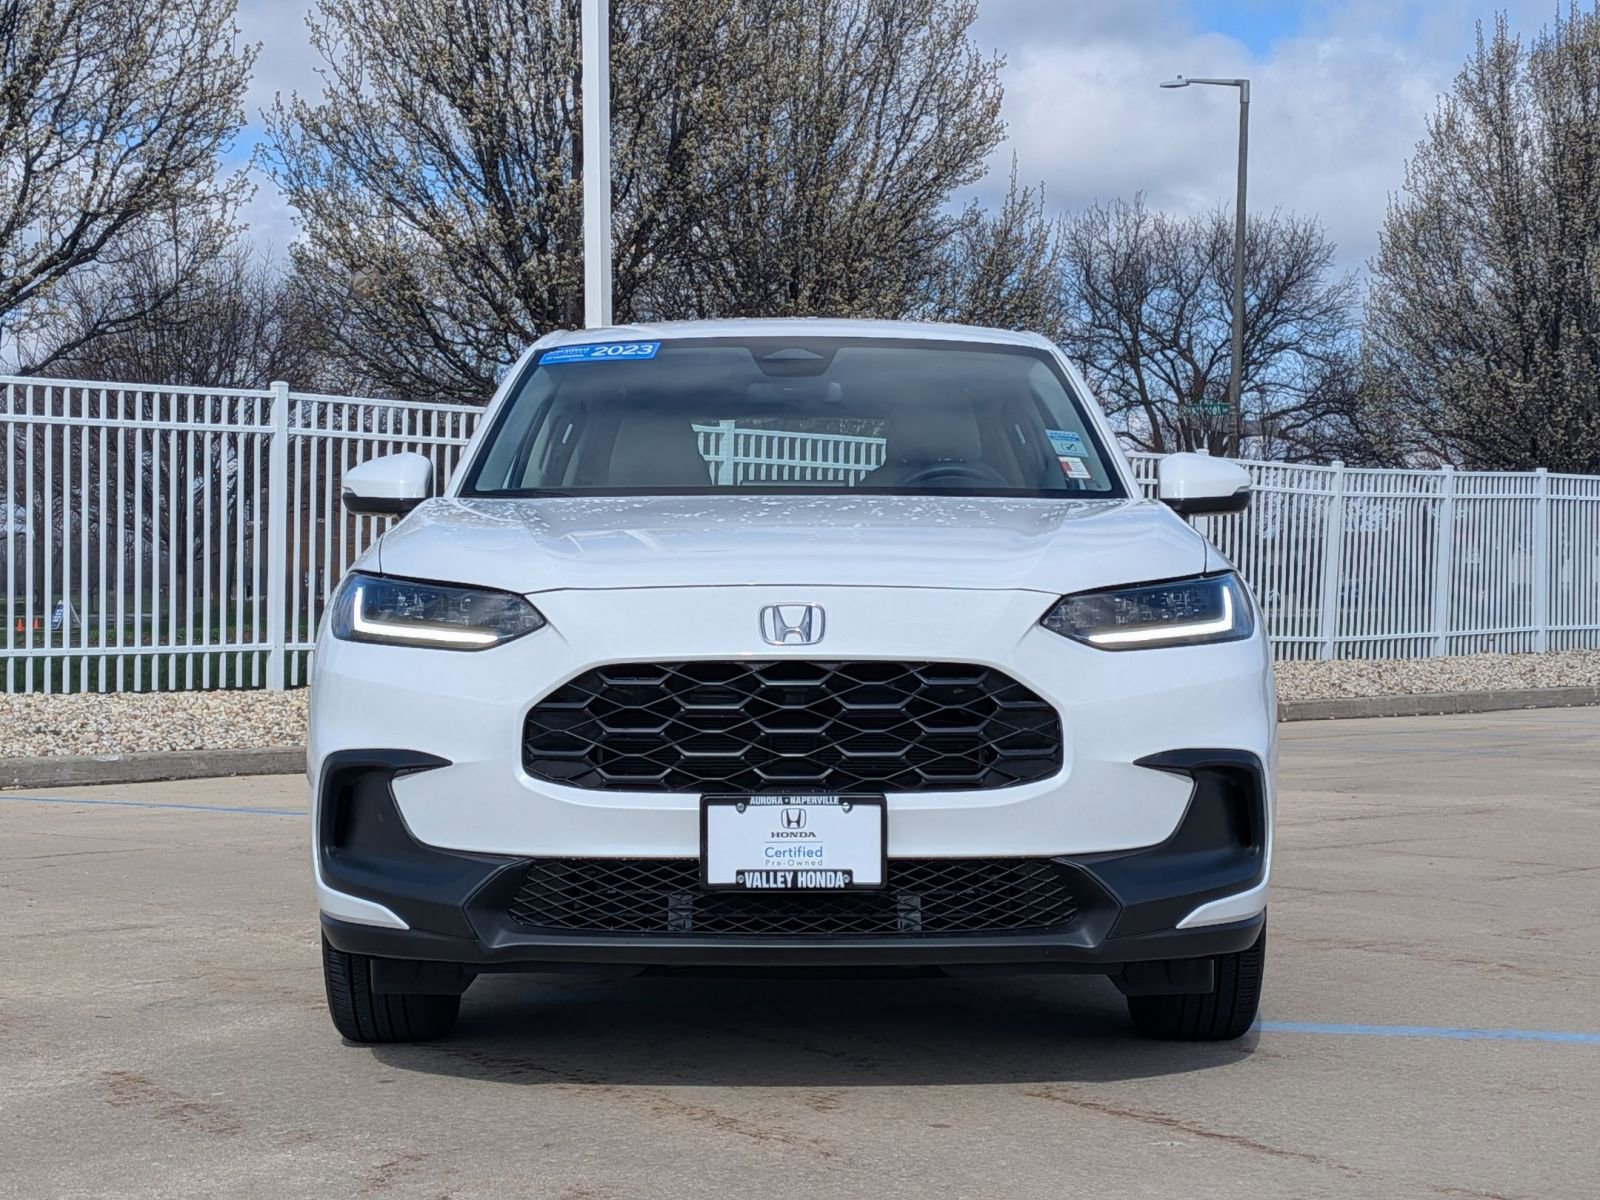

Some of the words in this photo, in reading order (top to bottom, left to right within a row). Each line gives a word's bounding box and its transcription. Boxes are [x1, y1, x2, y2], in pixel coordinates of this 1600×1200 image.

[590, 344, 653, 357] 2023
[750, 796, 783, 805] AURORA
[790, 796, 839, 805] NAPERVILLE
[764, 846, 823, 858] Certified
[744, 871, 793, 888] VALLEY
[798, 871, 845, 888] HONDA
